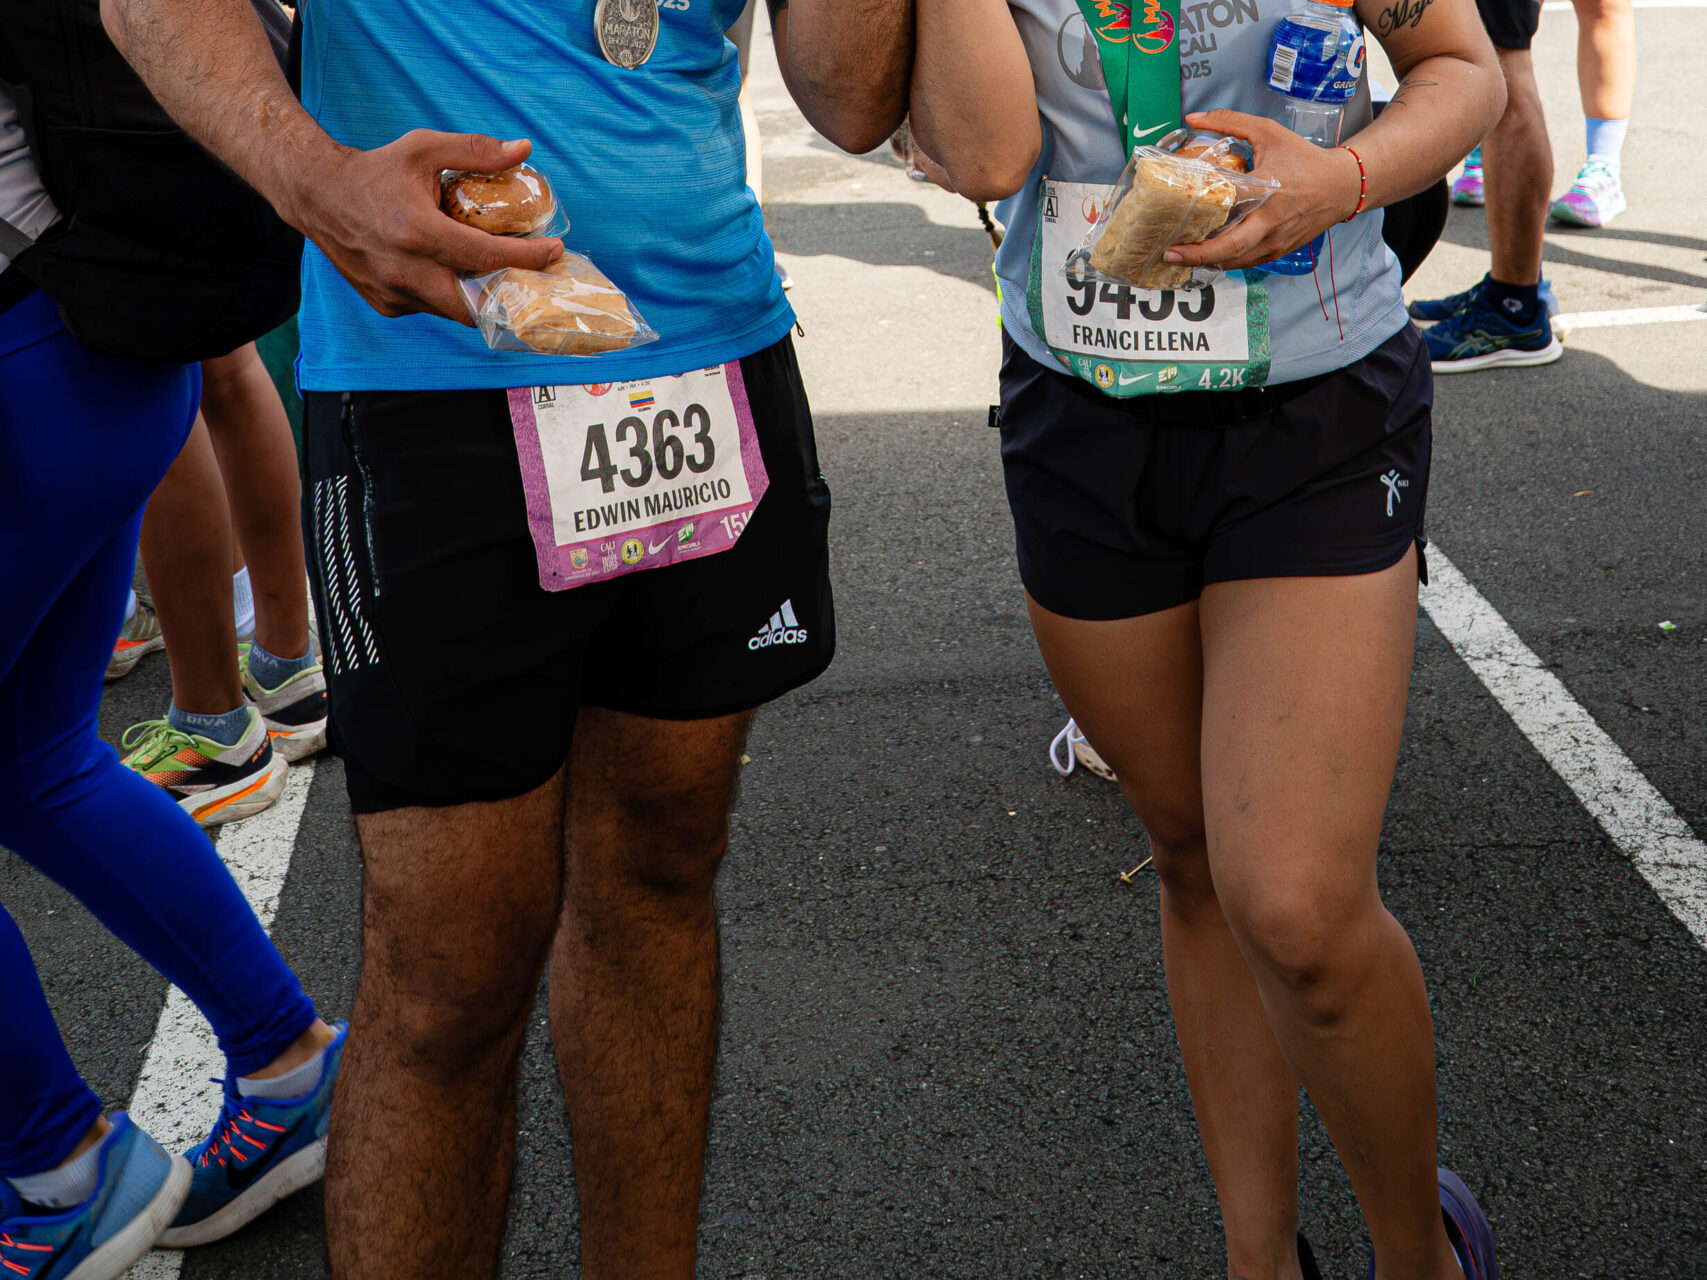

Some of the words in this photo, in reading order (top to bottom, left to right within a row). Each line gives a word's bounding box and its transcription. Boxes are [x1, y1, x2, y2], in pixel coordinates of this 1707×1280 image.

[1180, 59, 1213, 81] 025
[1046, 197, 1055, 217] A
[1073, 324, 1139, 351] FRANCI
[1144, 330, 1211, 352] ELENA
[1198, 367, 1247, 390] 4.2K
[538, 386, 551, 403] A
[580, 403, 716, 494] 4363
[574, 498, 641, 533] EDWIN
[644, 478, 731, 518] MAURICIO
[600, 540, 616, 553] CALI
[748, 626, 808, 651] adidas
